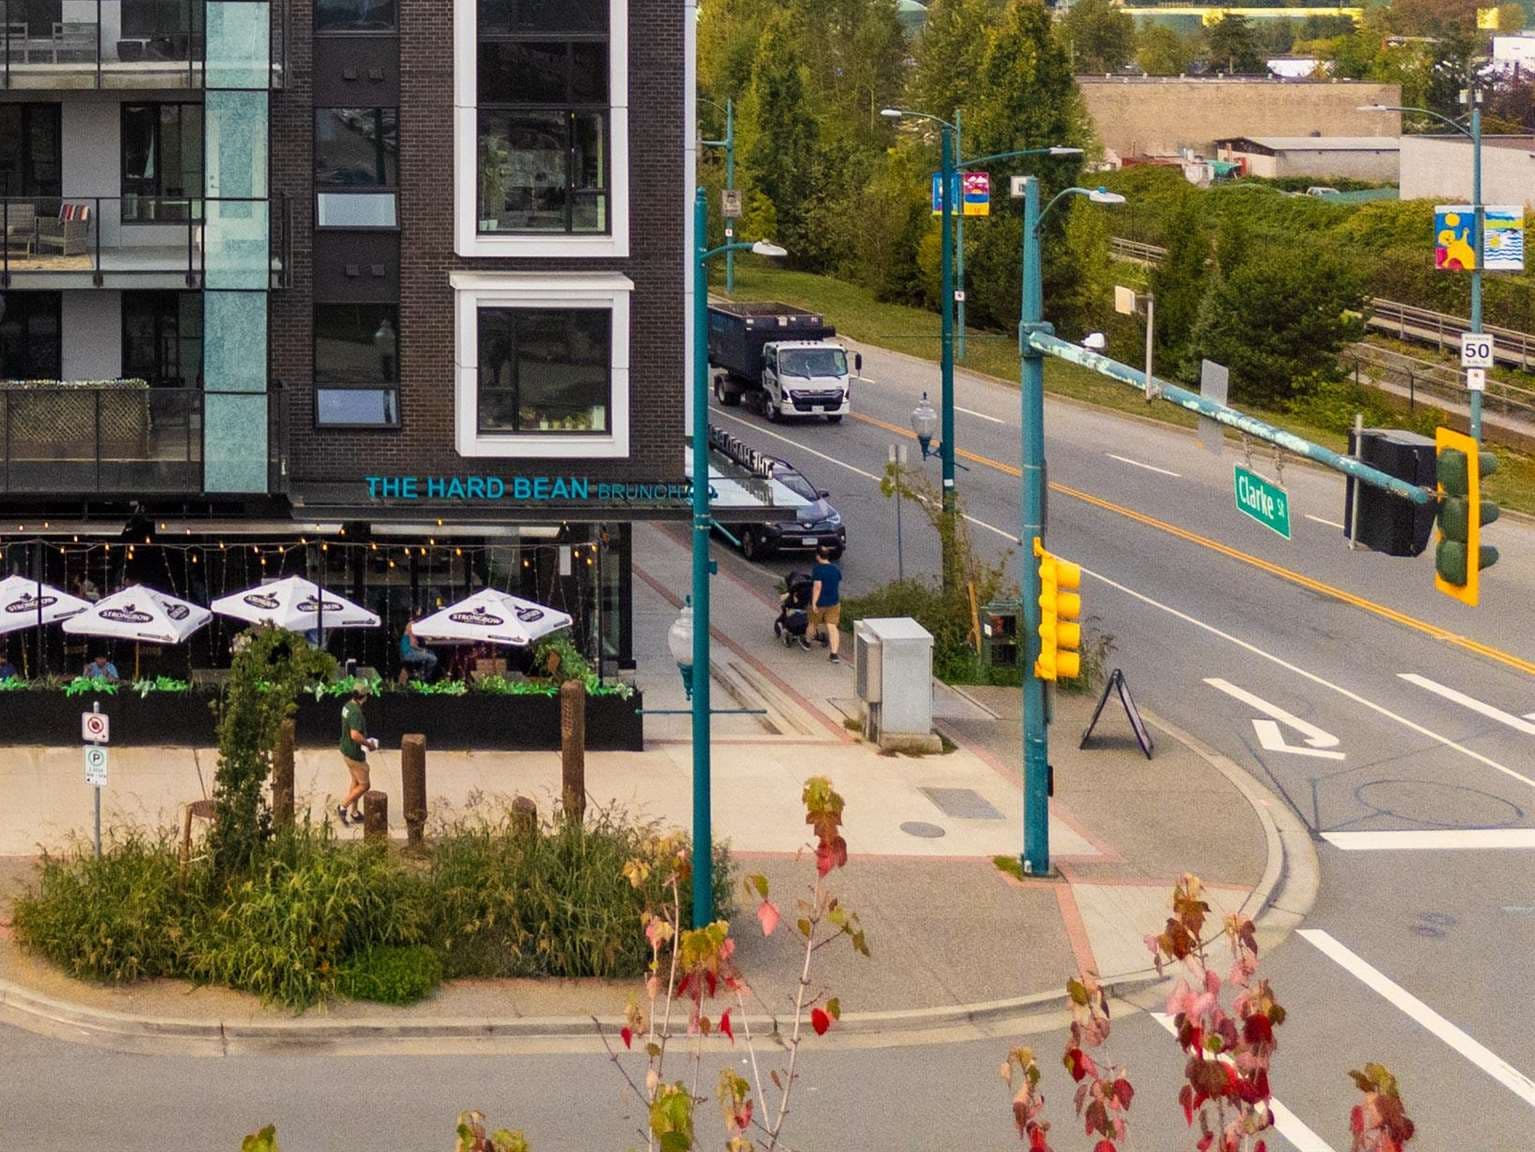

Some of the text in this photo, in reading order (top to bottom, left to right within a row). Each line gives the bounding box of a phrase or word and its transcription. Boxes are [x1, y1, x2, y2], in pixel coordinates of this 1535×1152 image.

[1465, 343, 1489, 358] 50
[365, 476, 417, 498] THE
[427, 476, 505, 498] HARD
[513, 476, 589, 498] BEAN
[598, 483, 682, 500] BRUNCH
[1238, 475, 1274, 520] Clarke
[92, 753, 101, 763] P
